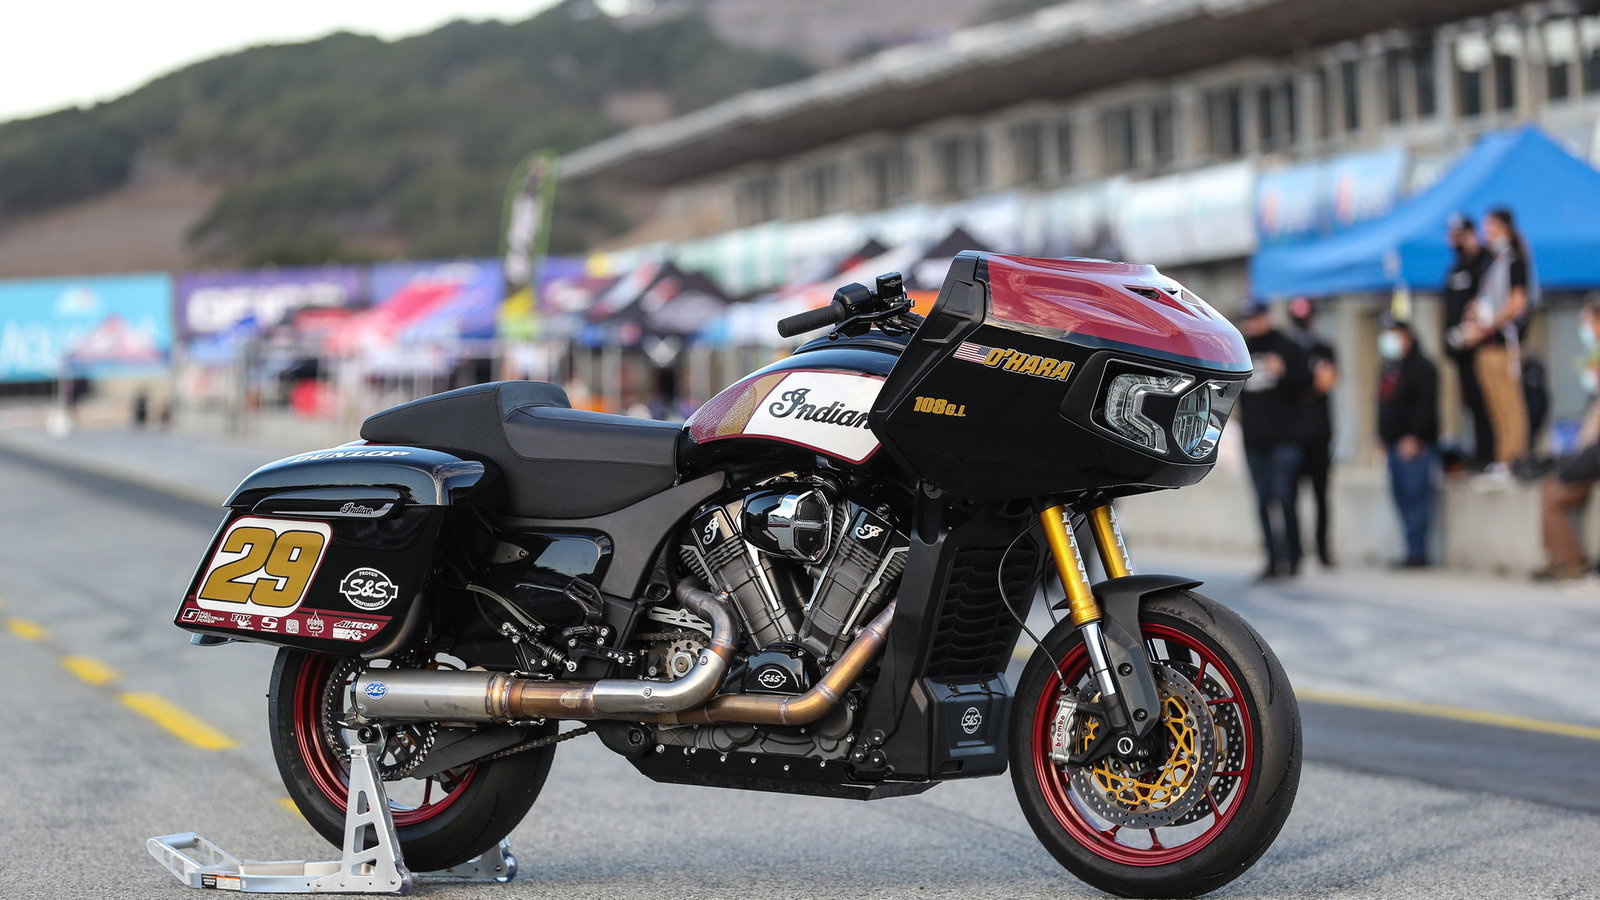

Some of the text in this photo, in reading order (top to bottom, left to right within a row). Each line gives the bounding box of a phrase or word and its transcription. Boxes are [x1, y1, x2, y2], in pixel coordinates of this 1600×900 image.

[983, 348, 1075, 382] O'HARA
[288, 451, 411, 464] DUNLOP
[341, 503, 373, 515] Indian
[198, 526, 325, 608] 29
[347, 578, 389, 598] S&S
[230, 614, 252, 624] FOX
[763, 674, 781, 683] S&S
[367, 686, 385, 694] S&S
[1055, 715, 1065, 747] brembo
